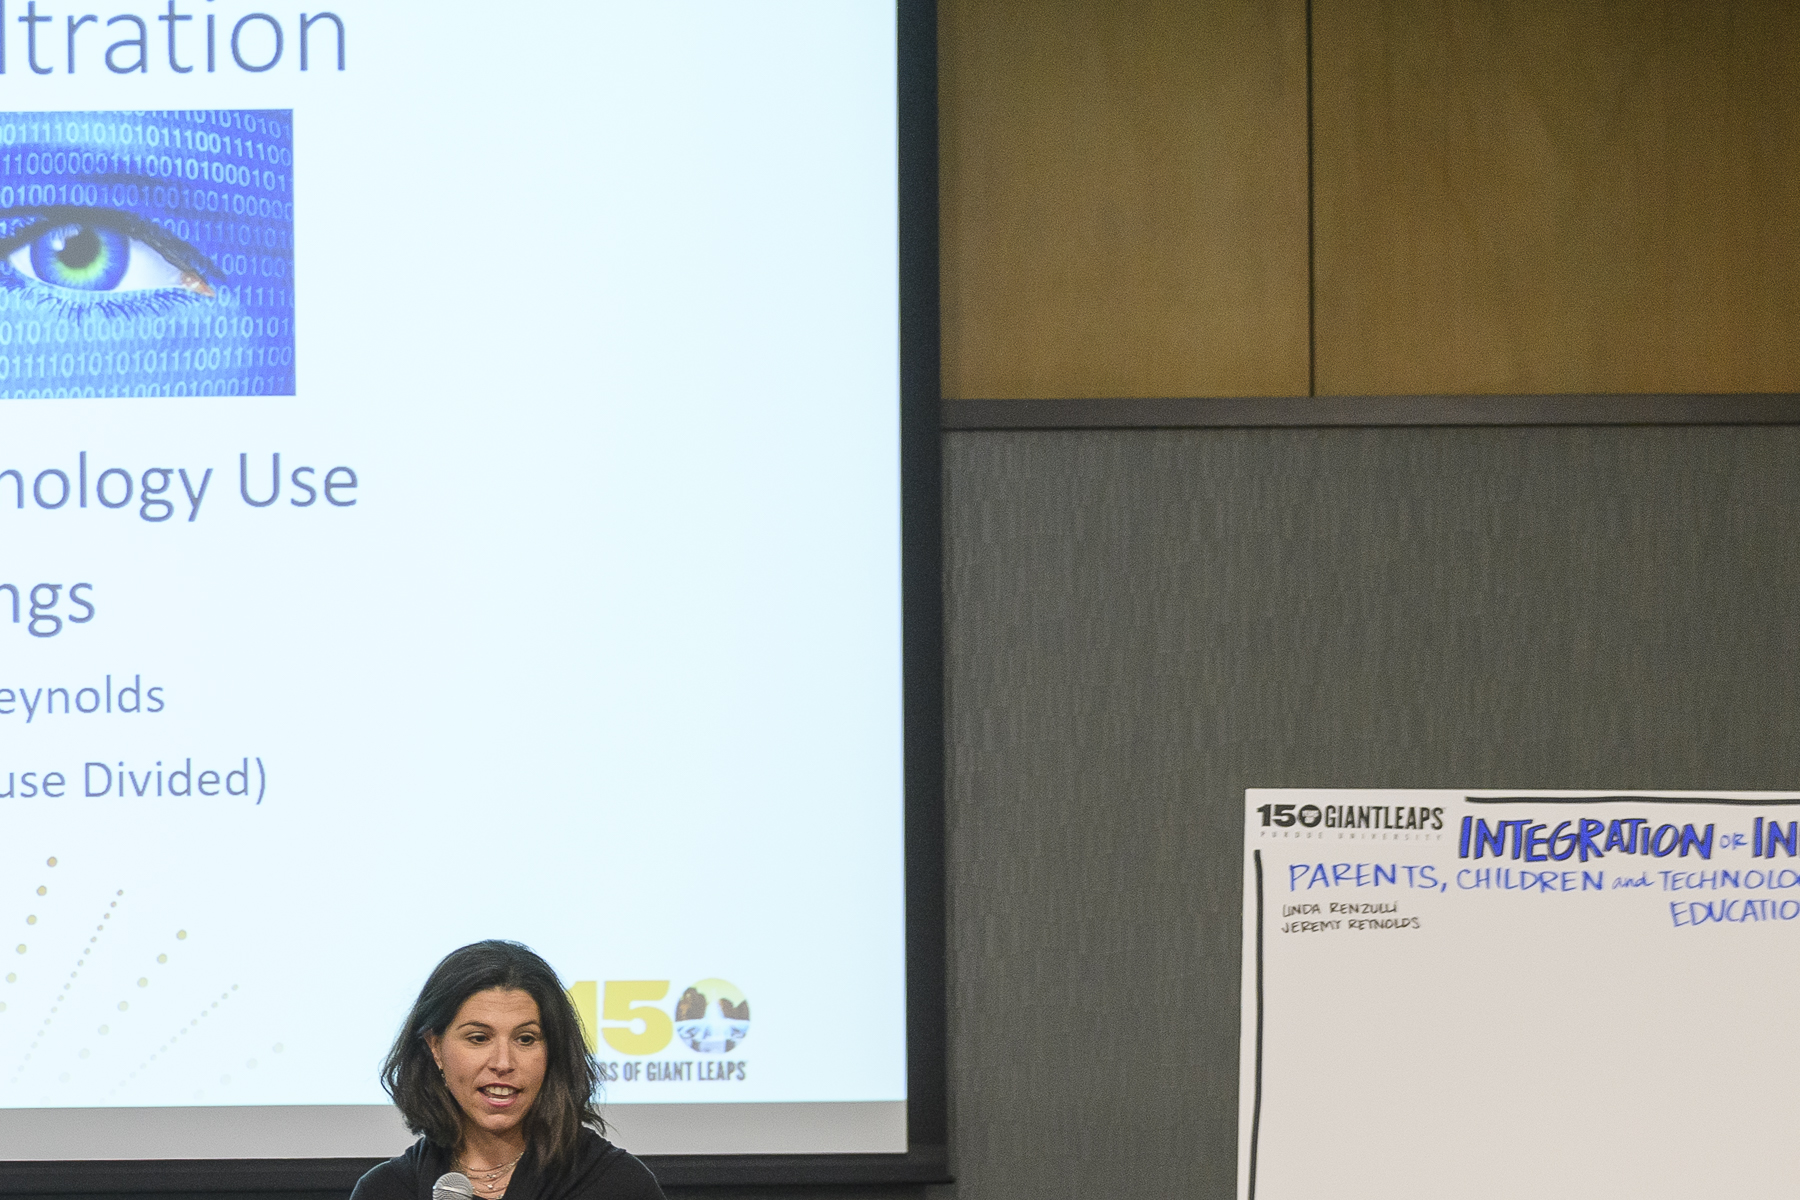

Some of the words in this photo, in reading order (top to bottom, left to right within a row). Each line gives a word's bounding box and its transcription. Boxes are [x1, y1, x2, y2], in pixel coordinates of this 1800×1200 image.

[240, 453, 360, 510] Use
[85, 757, 267, 807] Divided)
[1458, 815, 1715, 863] INTEGRATION
[1719, 832, 1748, 851] OR
[1752, 816, 1800, 861] IN
[1289, 861, 1448, 893] PARENTS,
[1456, 867, 1604, 893] CHILDREN
[1611, 871, 1655, 890] and
[1656, 869, 1800, 892] TECHNOLO
[1281, 919, 1342, 934] JEREMY
[1348, 916, 1421, 931] REYNOLDS
[1282, 903, 1322, 917] LINDA
[623, 1061, 642, 1082] OF
[646, 1061, 693, 1082] GIANT
[698, 1060, 746, 1082] LEAPS
